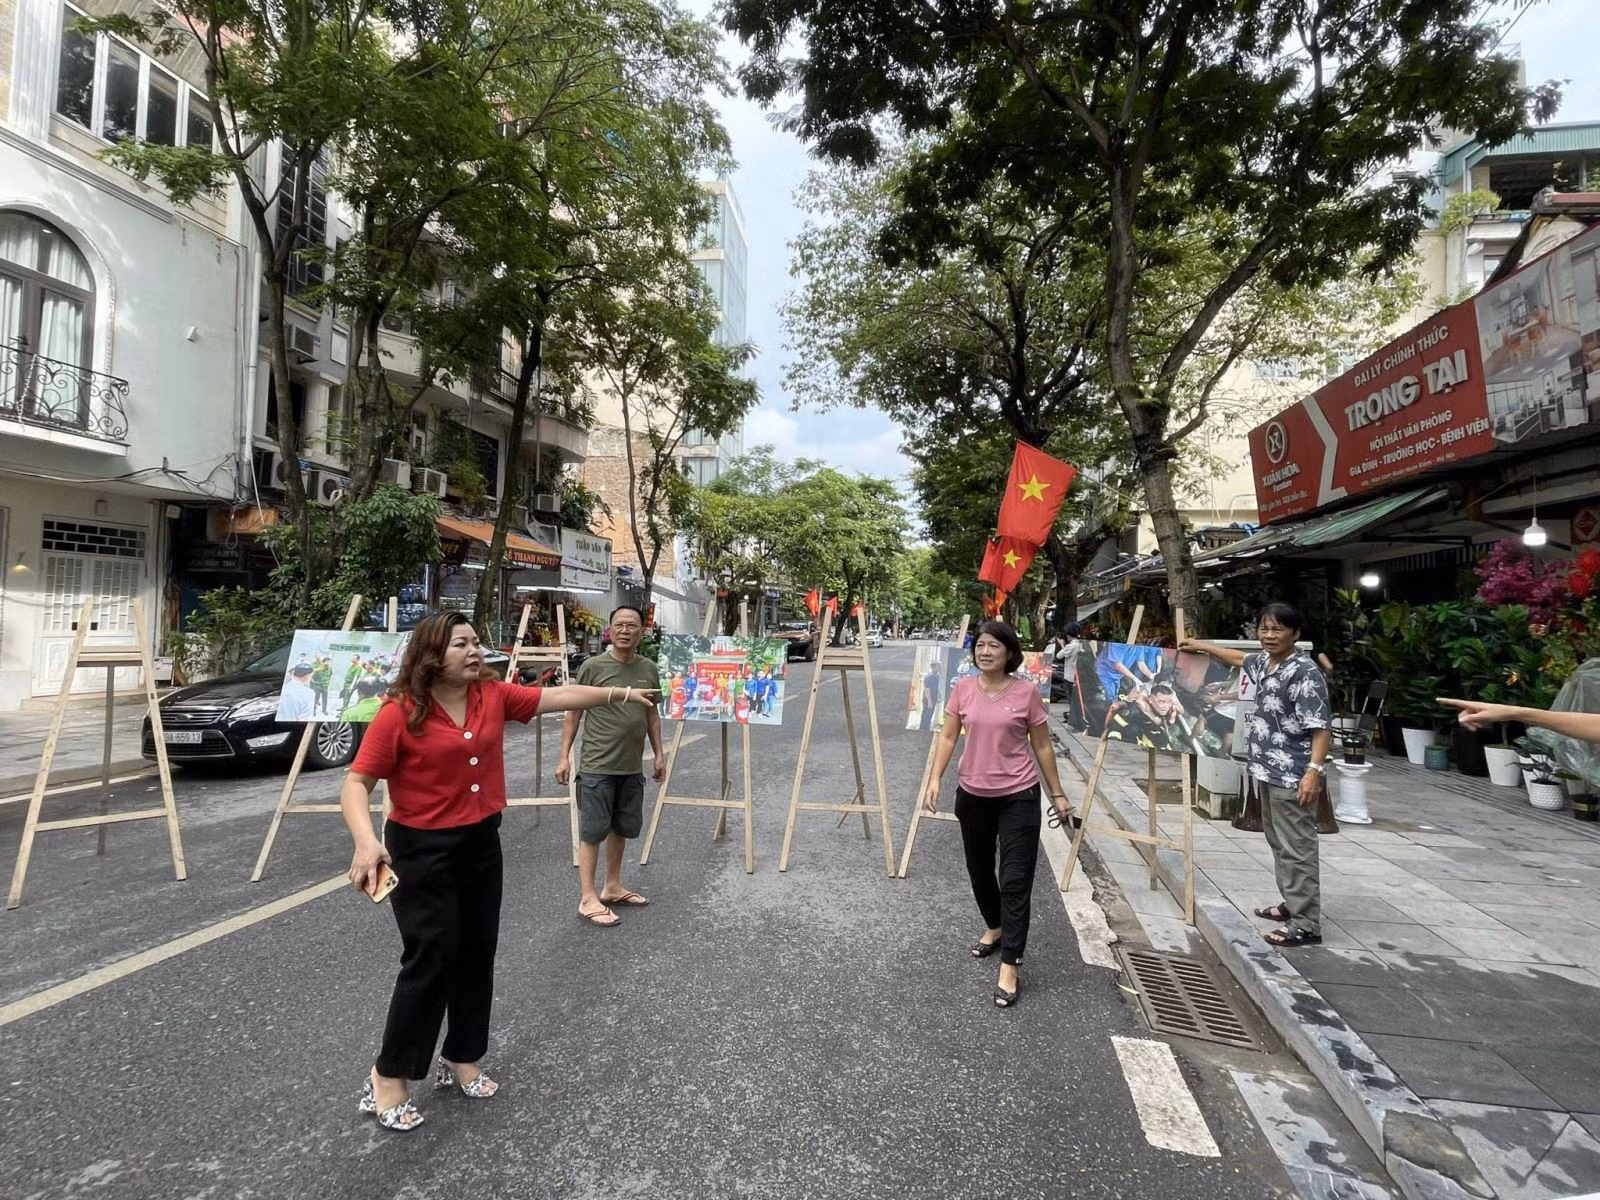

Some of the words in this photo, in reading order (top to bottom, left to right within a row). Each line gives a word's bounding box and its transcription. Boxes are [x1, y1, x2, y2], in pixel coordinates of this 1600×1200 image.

[1354, 371, 1370, 387] ĐẠI
[1370, 359, 1382, 378] LÝ
[1384, 344, 1416, 370] CHÍNH
[1418, 324, 1448, 352] THỨC
[1344, 375, 1421, 431] TRỌNG
[1423, 349, 1468, 394] TẠI
[1350, 466, 1362, 477] GIA
[1362, 458, 1378, 472] ĐÌNH
[1416, 437, 1436, 454] HỌC
[1441, 428, 1465, 446] BỆNH
[1466, 418, 1490, 436] VIỆN
[1370, 436, 1384, 452] NỘI
[1384, 426, 1402, 446] THẤT
[1420, 410, 1452, 432] PHÒNG
